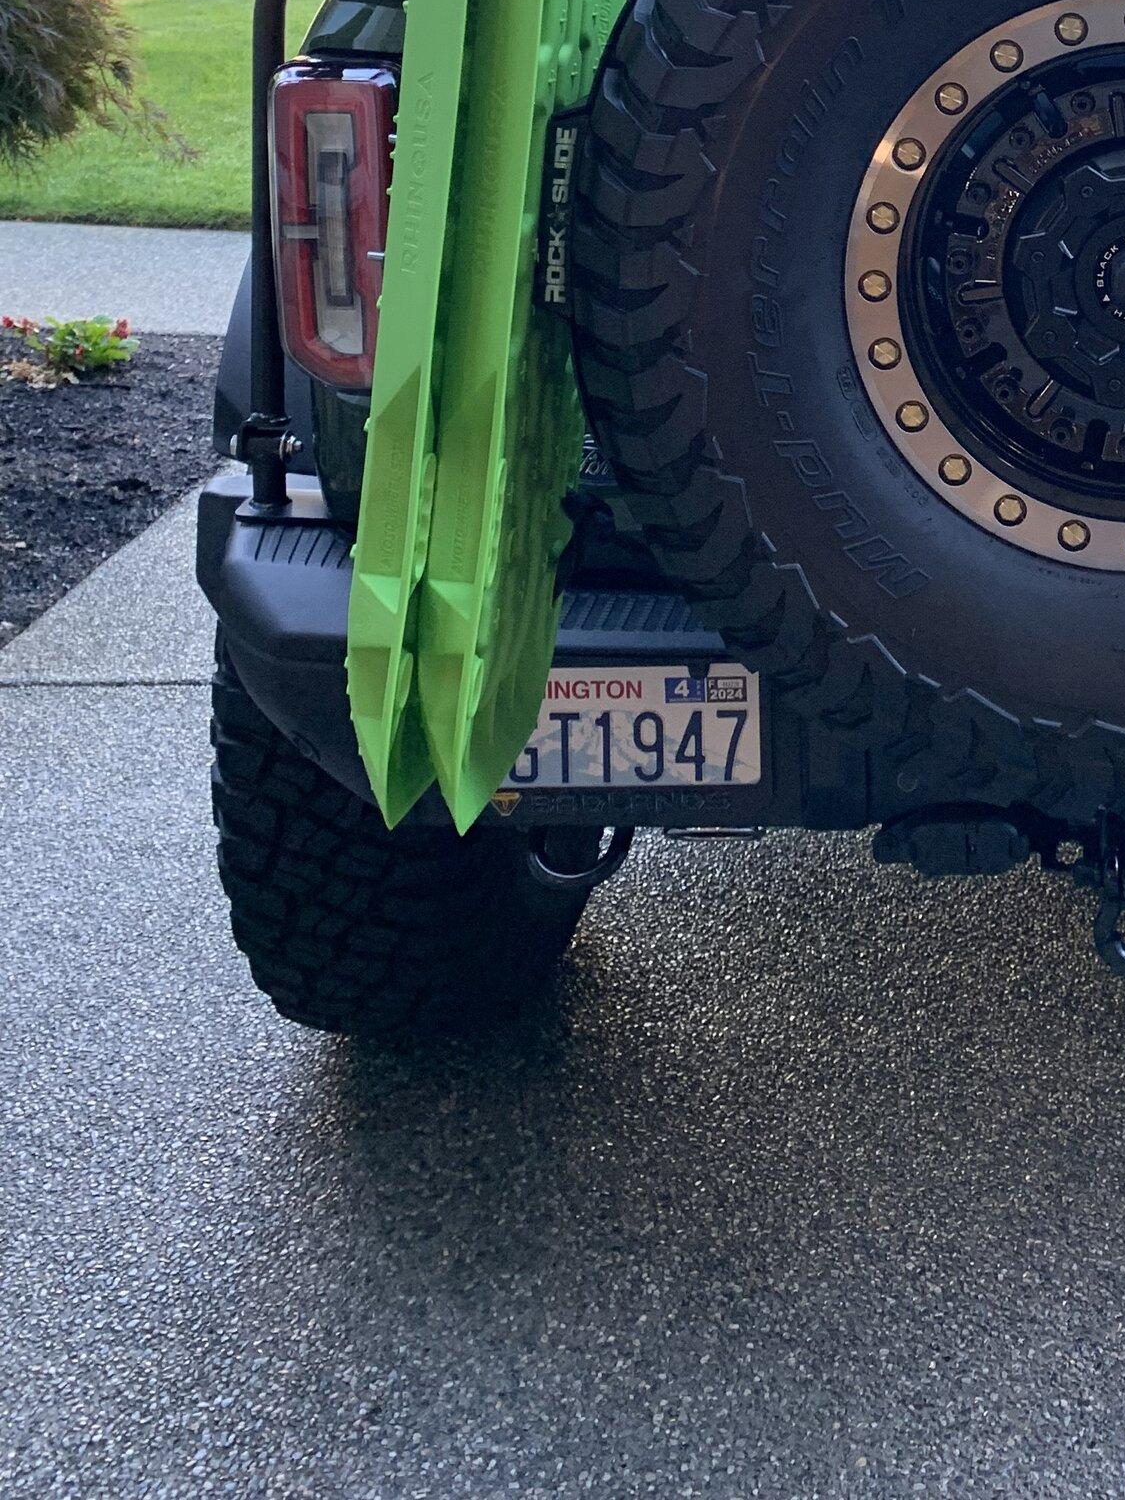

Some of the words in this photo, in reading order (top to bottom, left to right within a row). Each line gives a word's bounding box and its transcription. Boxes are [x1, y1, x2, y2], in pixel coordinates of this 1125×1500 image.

[551, 127, 577, 204] SLIDE
[544, 226, 567, 303] ROCK
[1096, 244, 1119, 288] BLACK
[545, 680, 642, 700] INGTON
[674, 680, 690, 698] 4
[709, 689, 744, 700] 2024
[509, 709, 748, 784] GT1947
